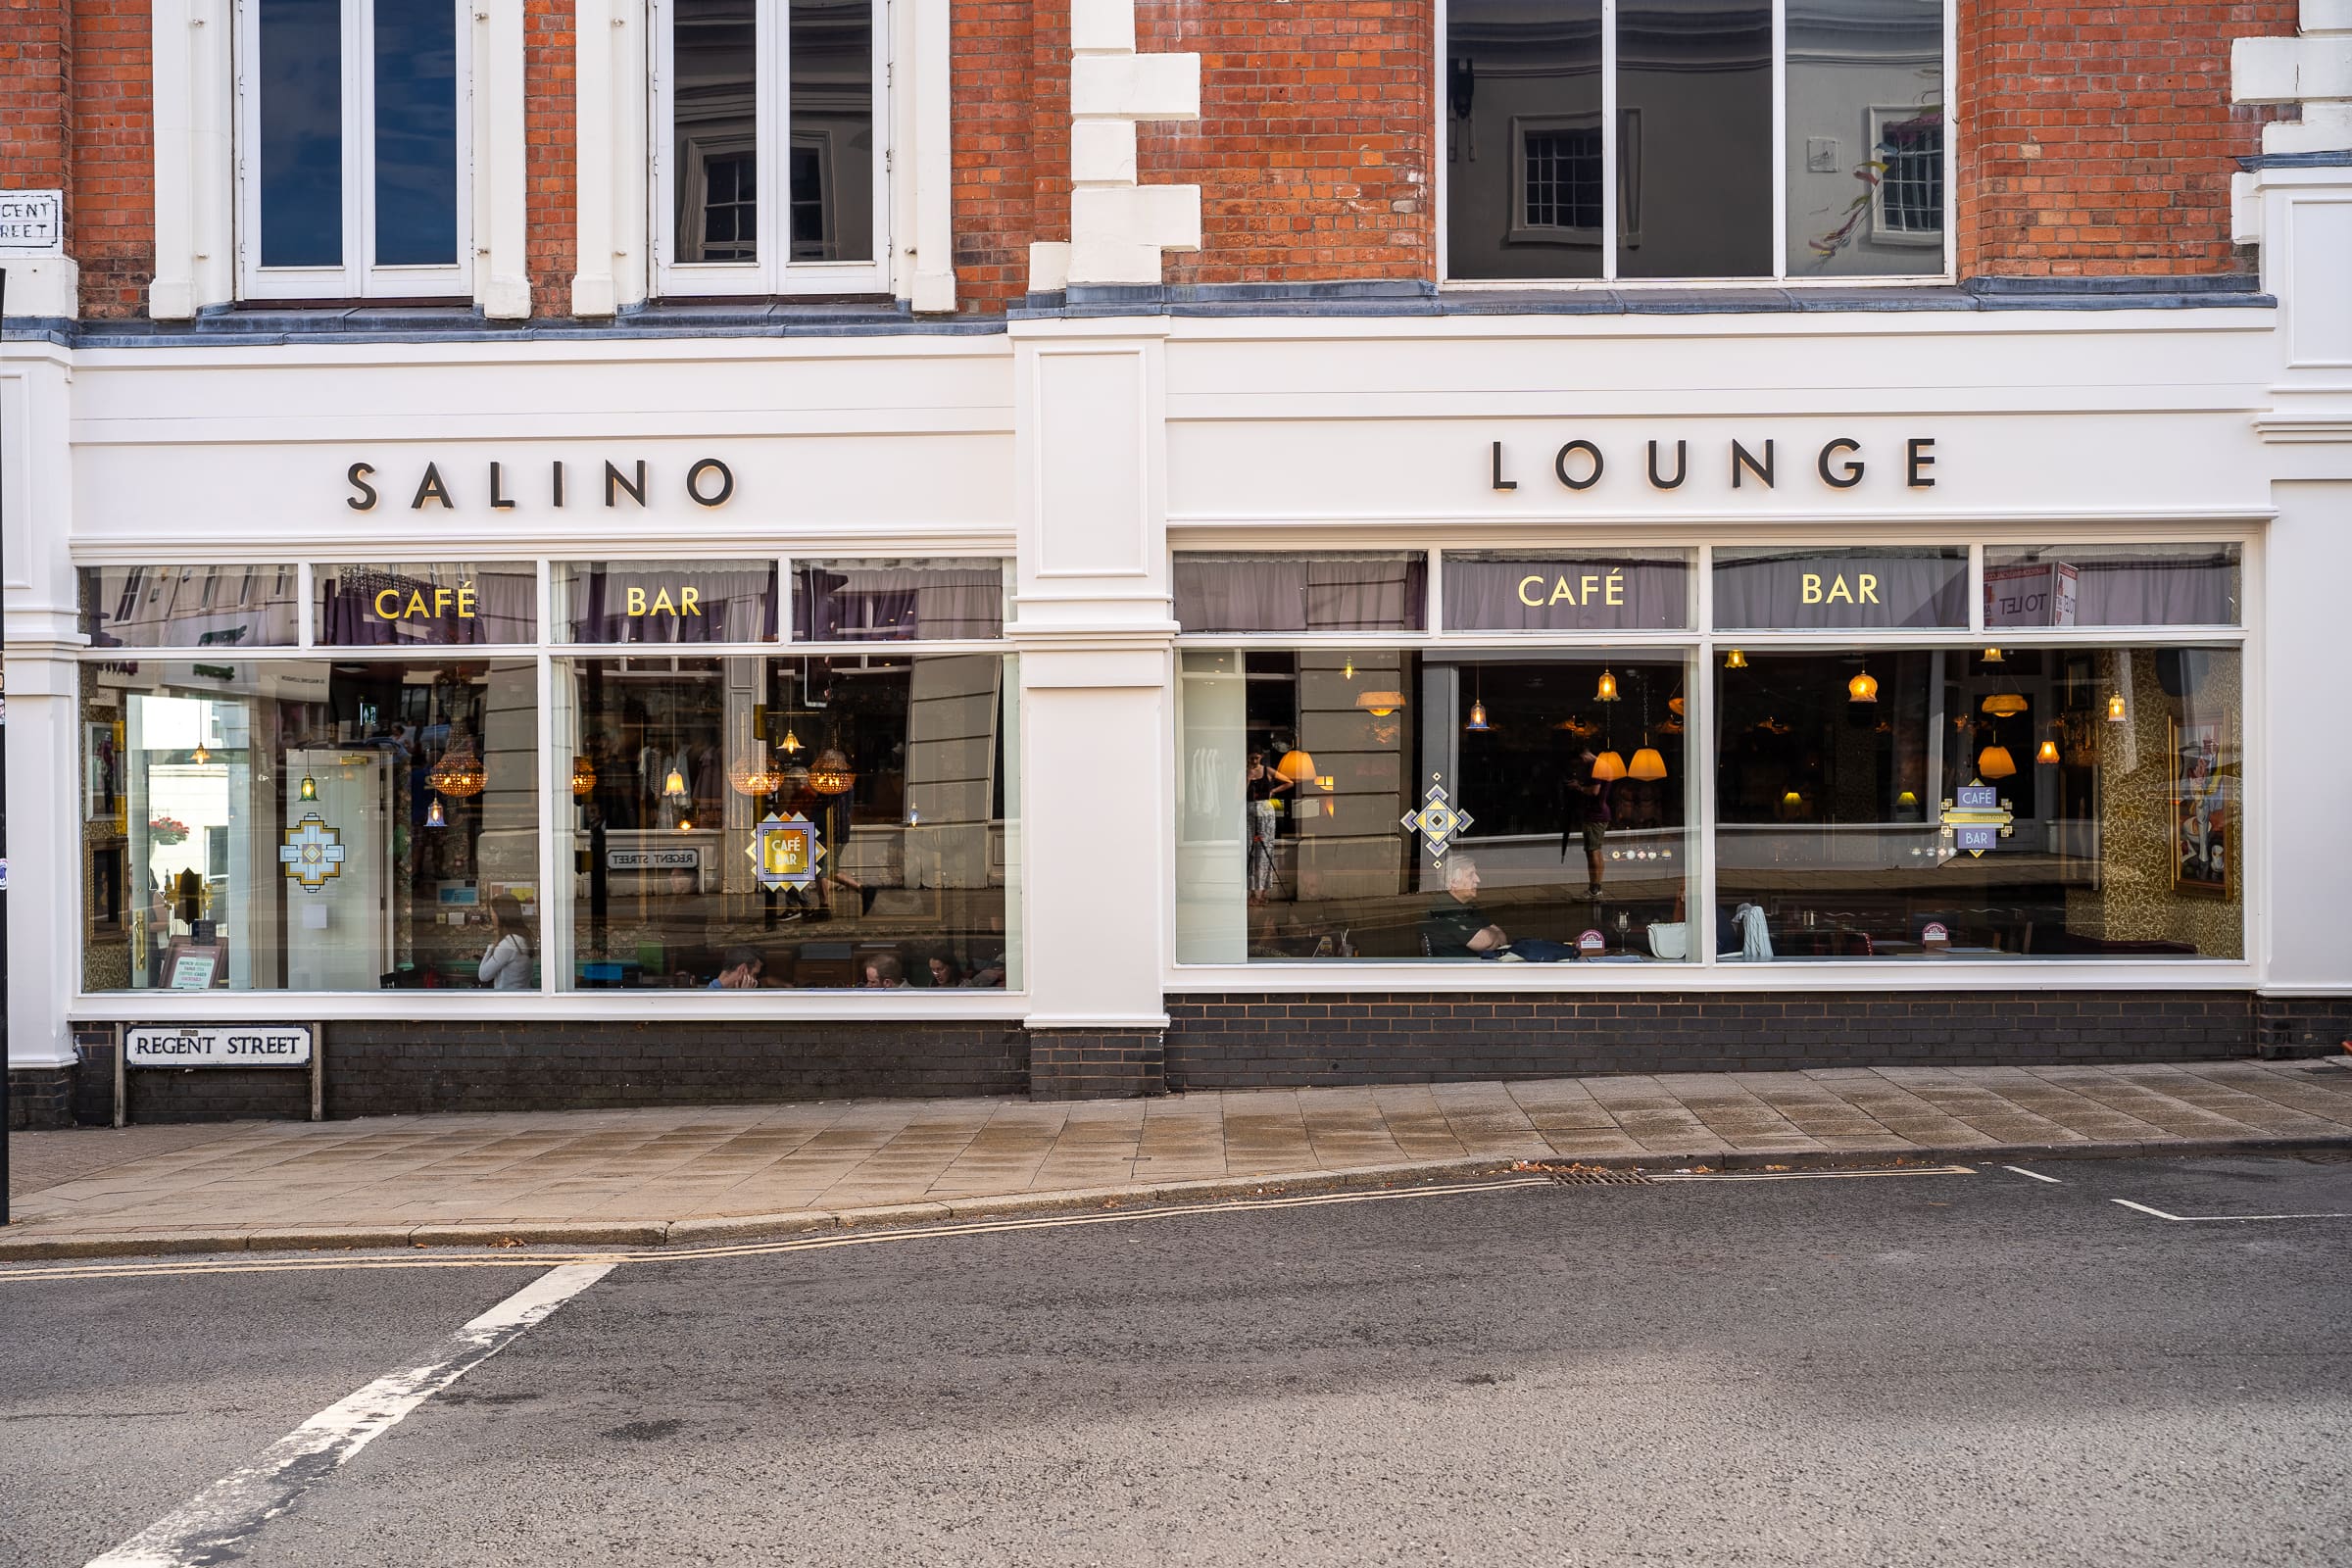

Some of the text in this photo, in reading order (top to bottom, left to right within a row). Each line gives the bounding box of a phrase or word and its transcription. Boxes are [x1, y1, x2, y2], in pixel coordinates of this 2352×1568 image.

[1493, 437, 1936, 491] LOUNGE
[346, 458, 734, 511] SALINO
[374, 581, 476, 620] CAFÉ
[627, 587, 702, 617] BAR
[1518, 567, 1624, 607] CAFÉ
[1801, 573, 1881, 605] BAR
[1962, 789, 1992, 805] CAFÉ
[771, 836, 801, 852] CAFÉ
[1965, 832, 1988, 845] BAR
[775, 853, 798, 865] BAR
[136, 1036, 300, 1054] REGENT STREET
